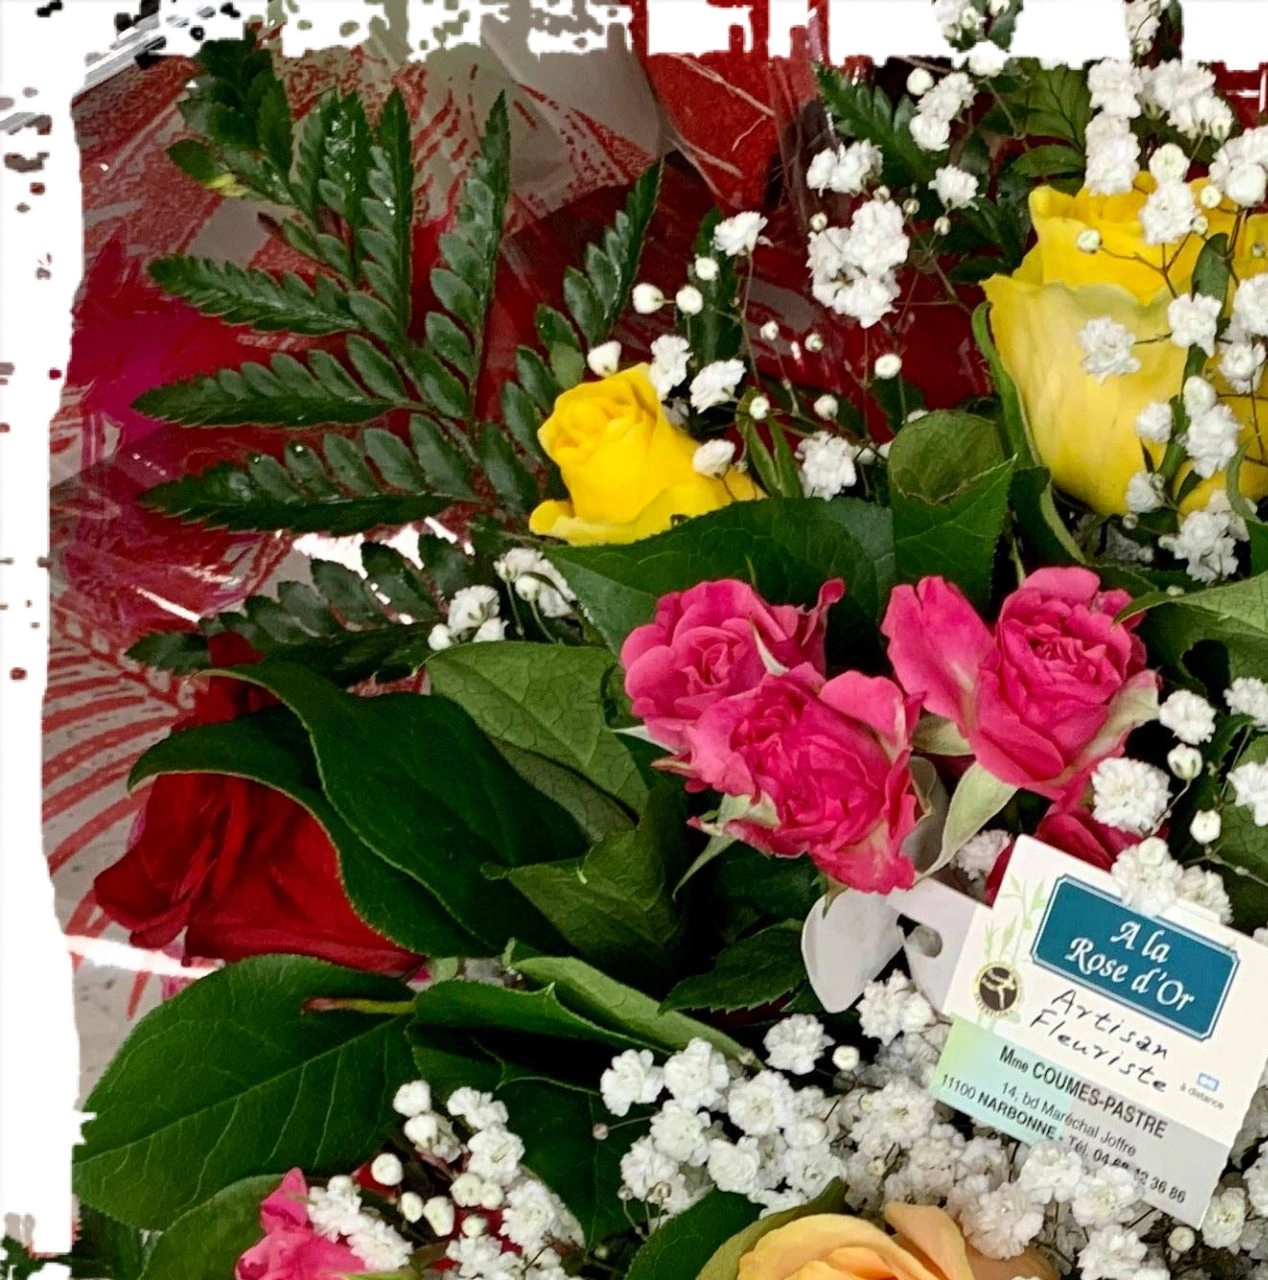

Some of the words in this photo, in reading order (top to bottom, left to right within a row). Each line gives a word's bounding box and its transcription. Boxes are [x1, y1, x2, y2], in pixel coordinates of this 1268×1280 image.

[1064, 937, 1129, 983] Rose
[1131, 968, 1195, 1011] d'Or
[1110, 920, 1142, 950] A
[1141, 929, 1171, 963] la
[1030, 1009, 1167, 1093] Fleuriste
[1050, 989, 1168, 1060] Artisan
[1000, 1045, 1029, 1073] Mme
[1032, 1061, 1168, 1139] COUMES-PASTRE
[1001, 1081, 1018, 1101] 14,
[1023, 1091, 1040, 1109] bd
[1041, 1100, 1100, 1139] Maréchal
[1100, 1131, 1137, 1157] Joffre
[942, 1073, 977, 1100] 11100
[977, 1091, 1058, 1141] NARBONNE
[1069, 1135, 1088, 1157] Tél.
[1093, 1148, 1110, 1166] 04
[1150, 1176, 1168, 1194] 36
[1168, 1186, 1187, 1204] 86
